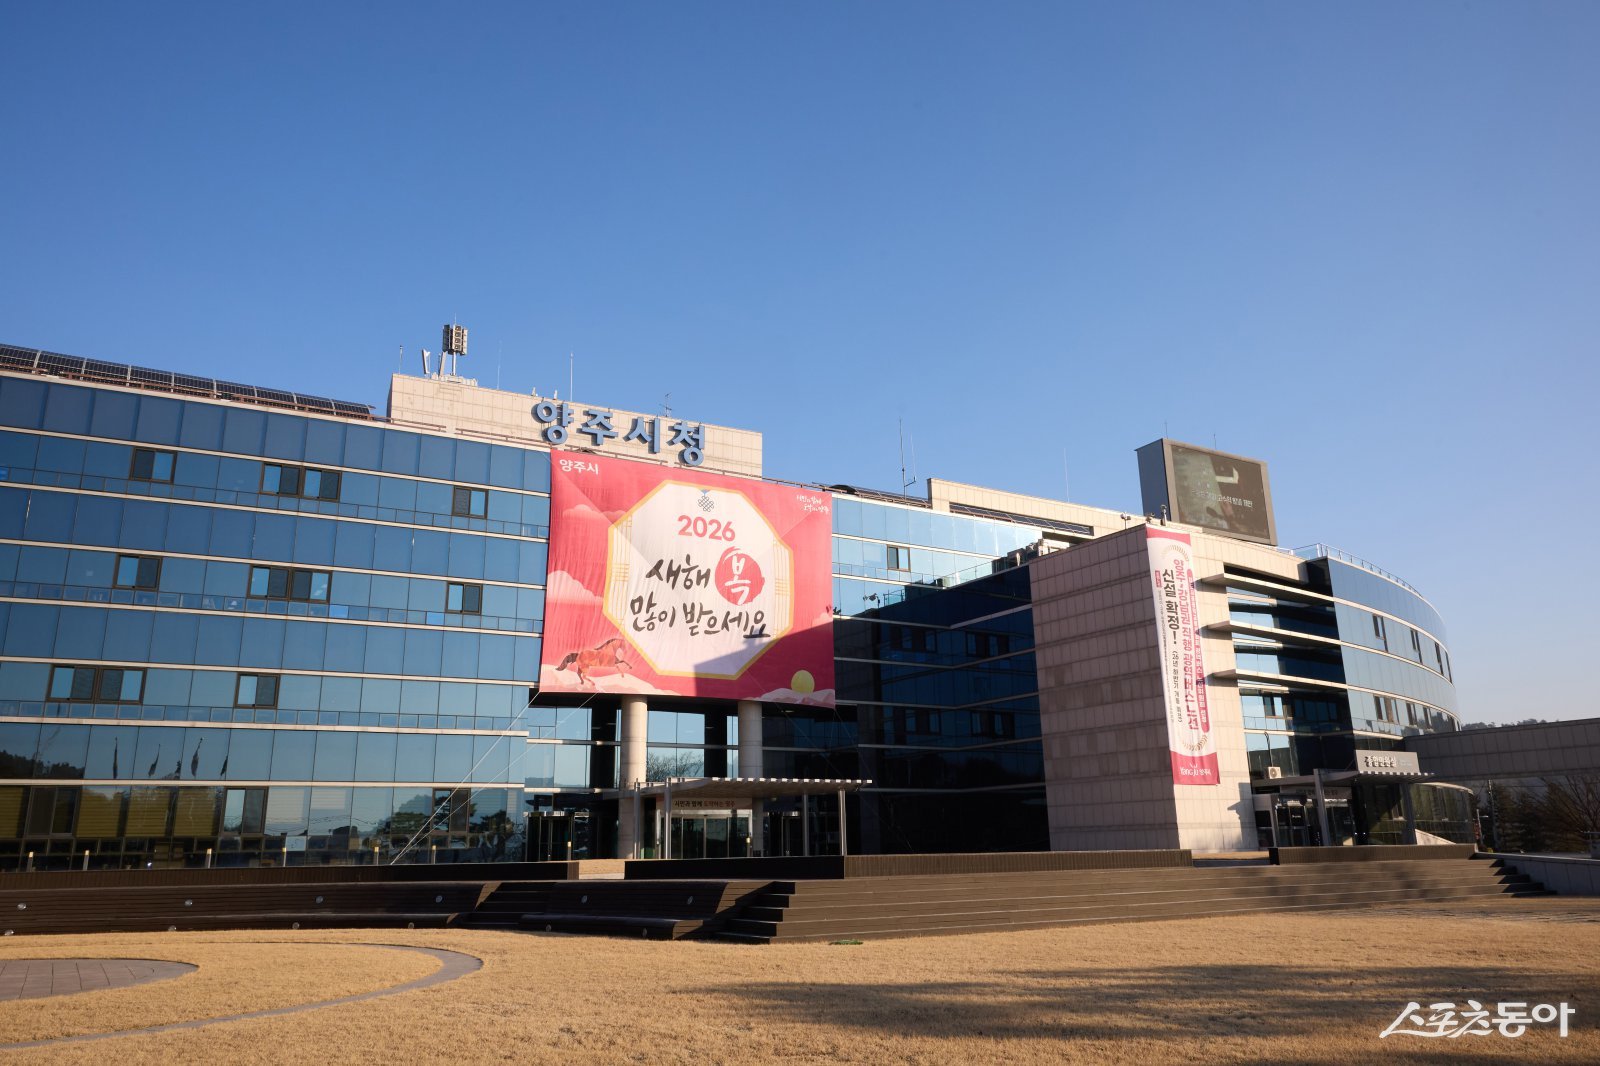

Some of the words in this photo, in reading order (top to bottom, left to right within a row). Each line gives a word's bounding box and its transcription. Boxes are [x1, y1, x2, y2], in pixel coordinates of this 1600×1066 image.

[532, 401, 705, 466] 양주시청
[559, 459, 599, 475] 양주시
[677, 515, 736, 541] 2026
[645, 554, 711, 590] 새해
[724, 554, 751, 605] 복
[1163, 569, 1176, 598] 신설
[630, 591, 676, 632] 많이
[682, 602, 771, 638] 받으세요
[1165, 601, 1180, 644] 확정!
[1182, 627, 1193, 651] 직행
[1184, 653, 1195, 702] 광역버스
[1187, 705, 1199, 729] 노선
[1366, 756, 1397, 768] 종합민원실
